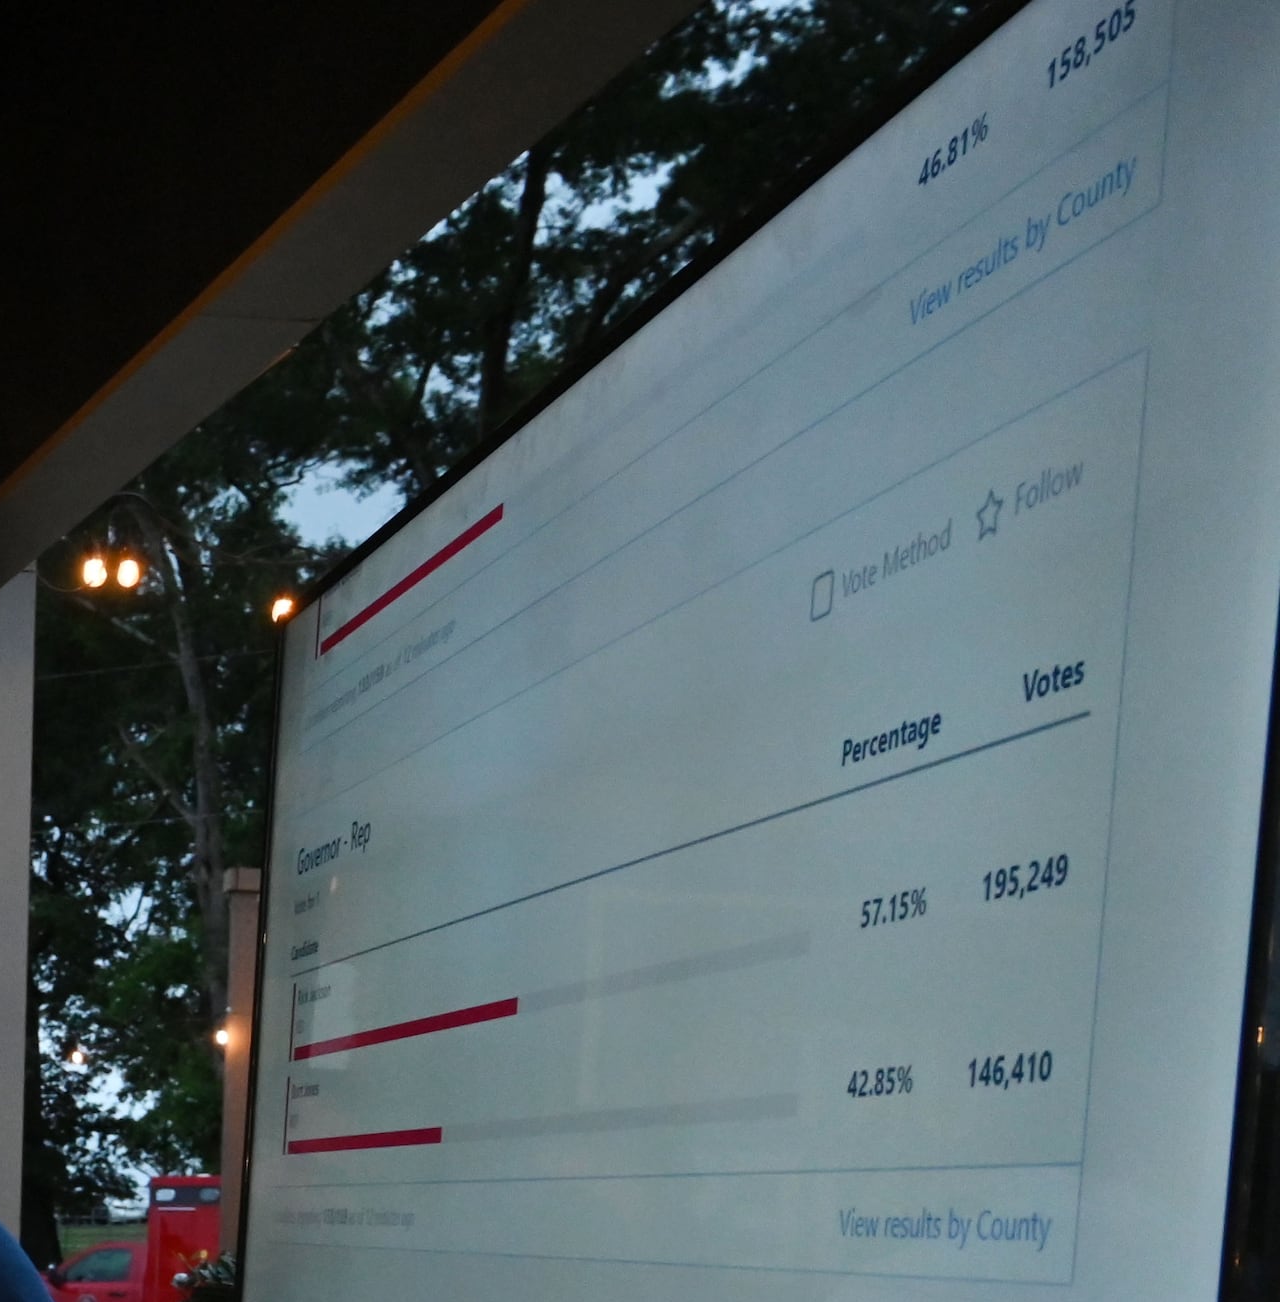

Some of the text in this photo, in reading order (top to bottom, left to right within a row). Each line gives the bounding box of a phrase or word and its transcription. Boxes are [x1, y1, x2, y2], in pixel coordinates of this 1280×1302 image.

[916, 0, 1137, 186] 46.81% 158,505
[909, 154, 1139, 326] View results by County
[842, 460, 1085, 599] Vote Method Follow
[841, 658, 1086, 767] Percentage Votes
[297, 834, 342, 875] Governor
[350, 820, 372, 854] Rep
[860, 853, 1069, 929] 57.15% 195,249
[846, 1050, 1053, 1099] 42.85% 146,410
[839, 1207, 1053, 1251] View results by County
